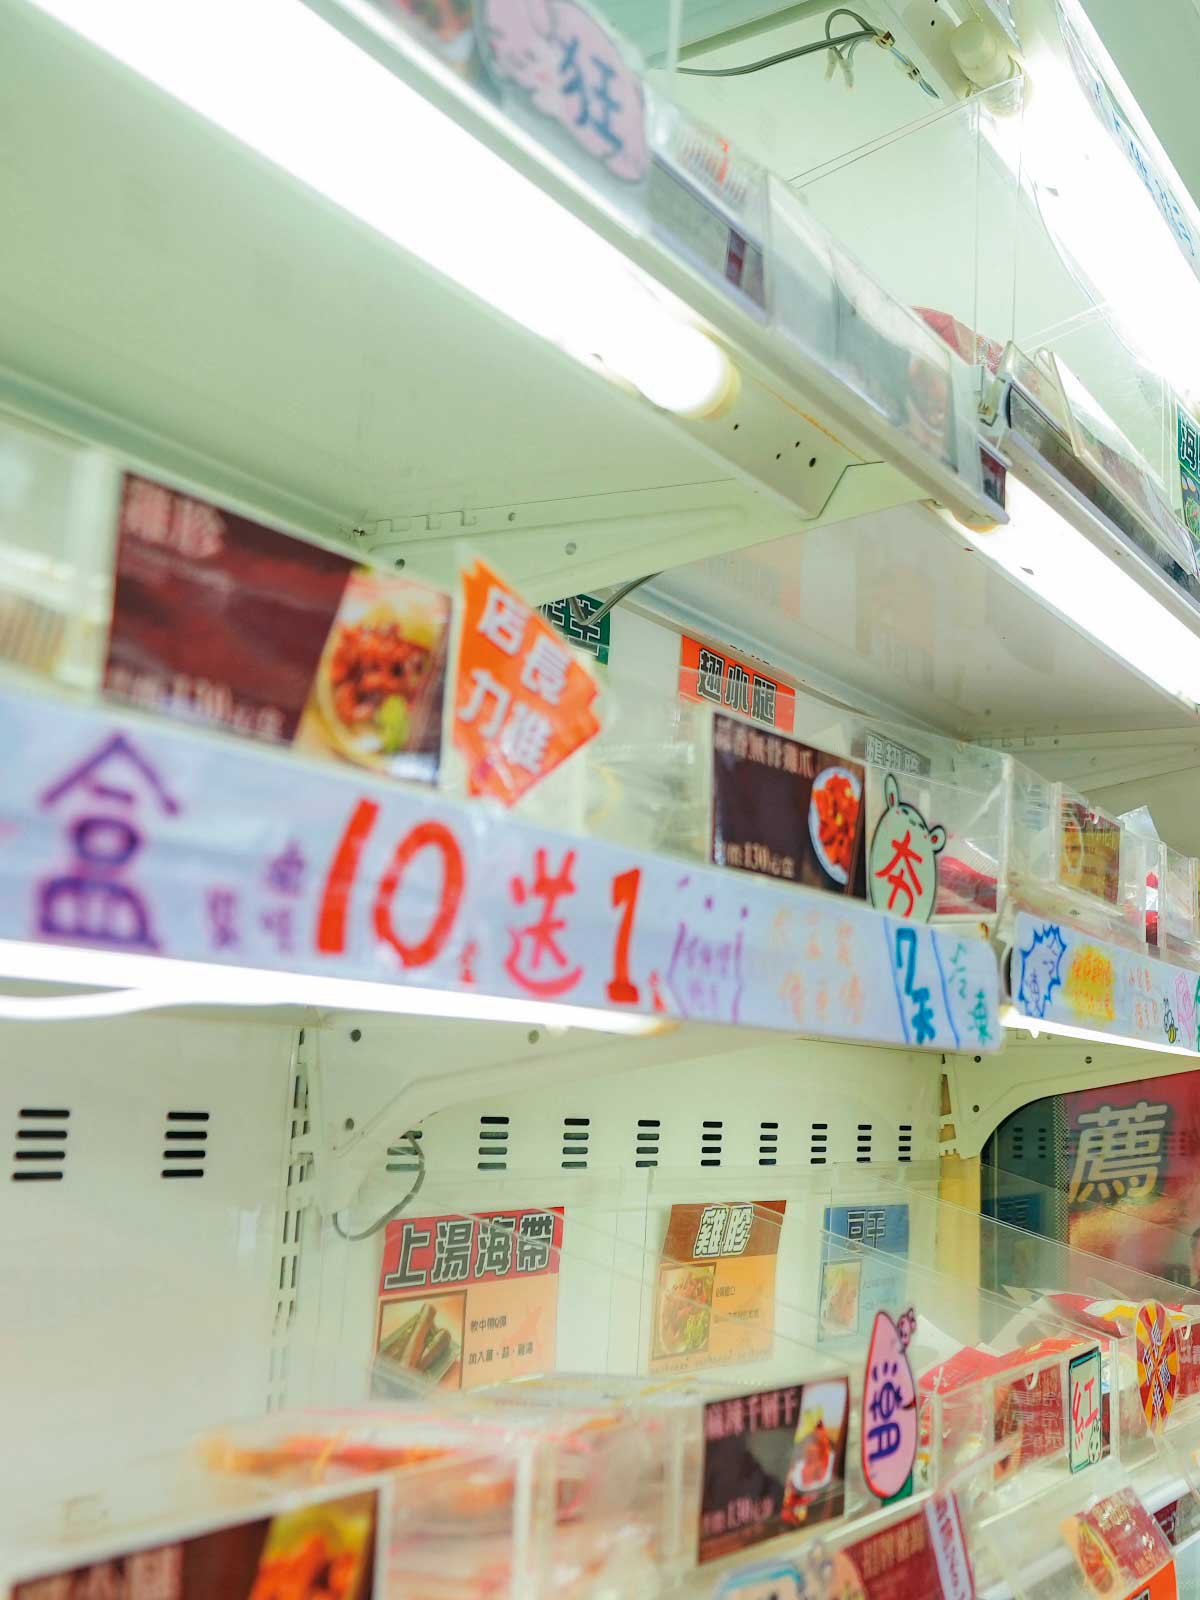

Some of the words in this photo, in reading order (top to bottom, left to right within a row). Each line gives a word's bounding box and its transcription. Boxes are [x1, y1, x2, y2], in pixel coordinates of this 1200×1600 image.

[476, 586, 572, 704] 店長
[697, 648, 777, 727] 翅小腿
[384, 1214, 554, 1290] 上湯海帶
[693, 1206, 753, 1258] 雞胗
